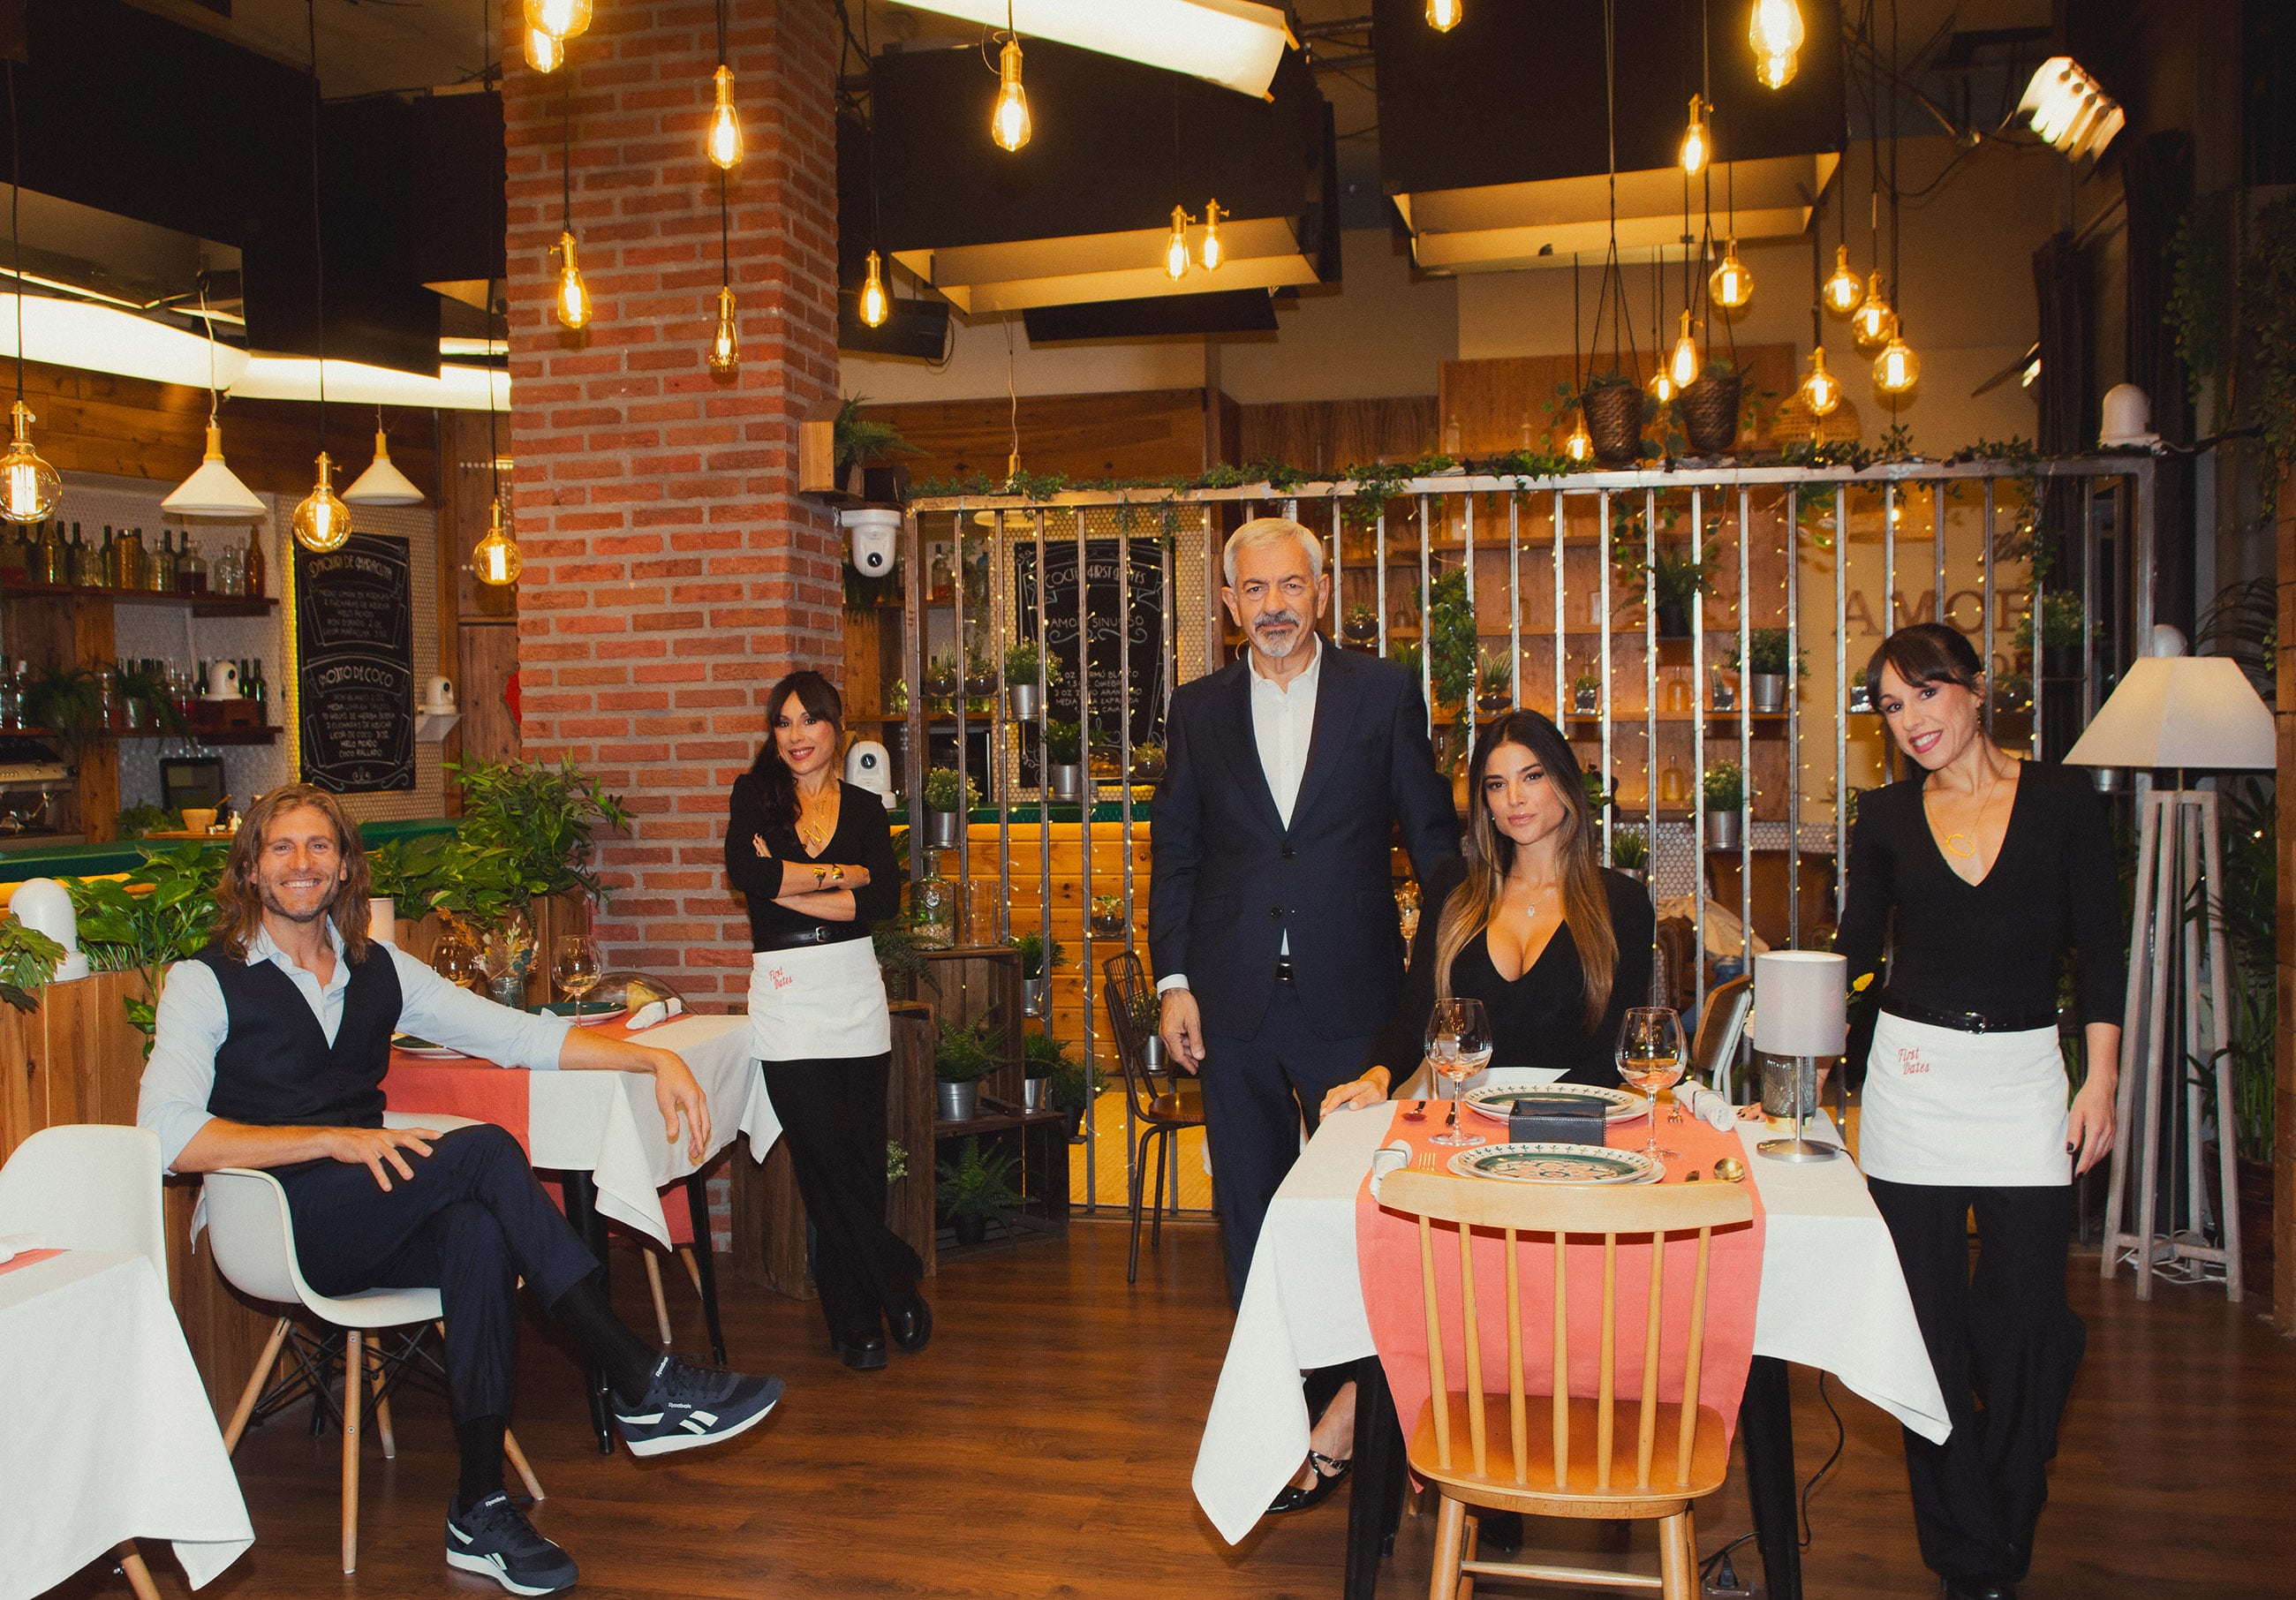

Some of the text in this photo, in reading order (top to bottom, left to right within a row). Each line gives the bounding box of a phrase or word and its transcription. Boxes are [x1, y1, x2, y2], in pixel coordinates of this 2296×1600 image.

[1051, 615, 1144, 629] AMO SINUSO
[319, 666, 394, 687] MOJITO DE COCO
[769, 966, 783, 981] First
[774, 976, 792, 989] Dates
[1899, 1047, 1919, 1063] First
[1903, 1061, 1930, 1075] Dates
[655, 1356, 668, 1377] Reebok
